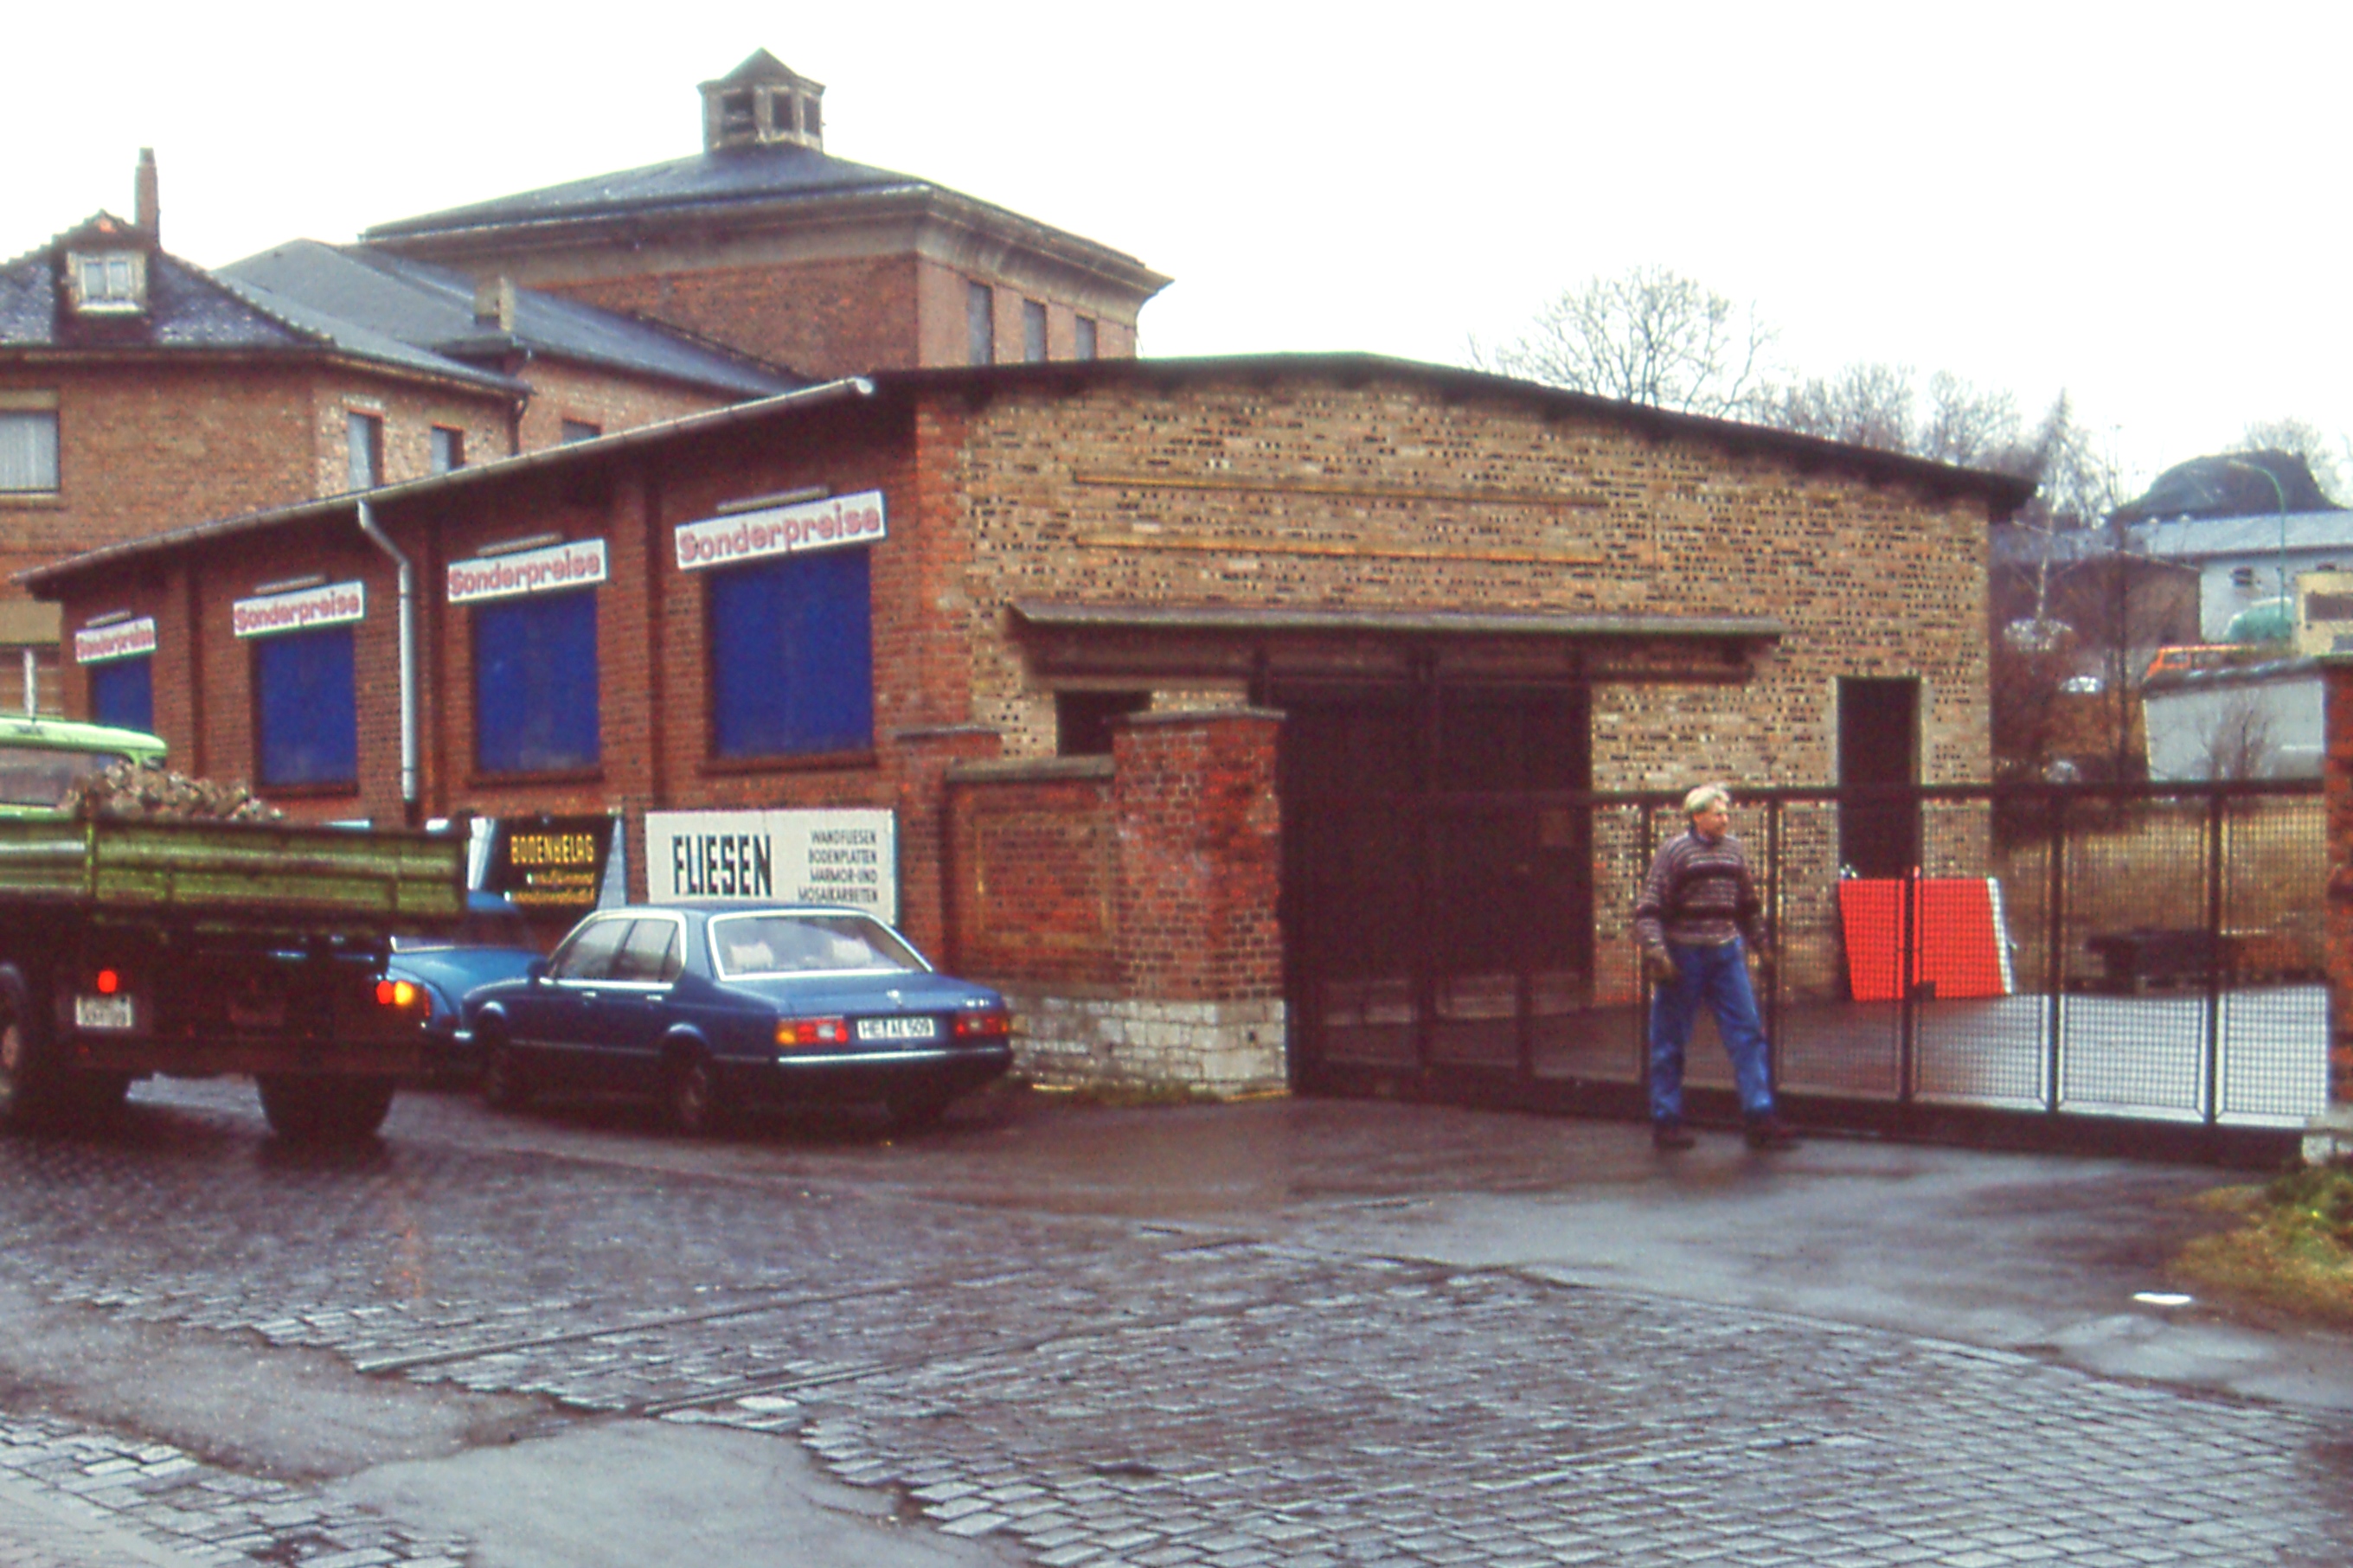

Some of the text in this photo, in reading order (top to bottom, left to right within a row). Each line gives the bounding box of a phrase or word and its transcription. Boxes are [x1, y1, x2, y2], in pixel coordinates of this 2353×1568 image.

[677, 502, 881, 562] Sonderpreise
[449, 547, 601, 597] Sonderpreise
[234, 590, 360, 632] Sonderpreise
[510, 835, 593, 864] BODENBELAG
[808, 848, 878, 864] BODENPLATTEN
[810, 829, 877, 845] WANDFLIESEN
[672, 834, 773, 897] FLIESEN
